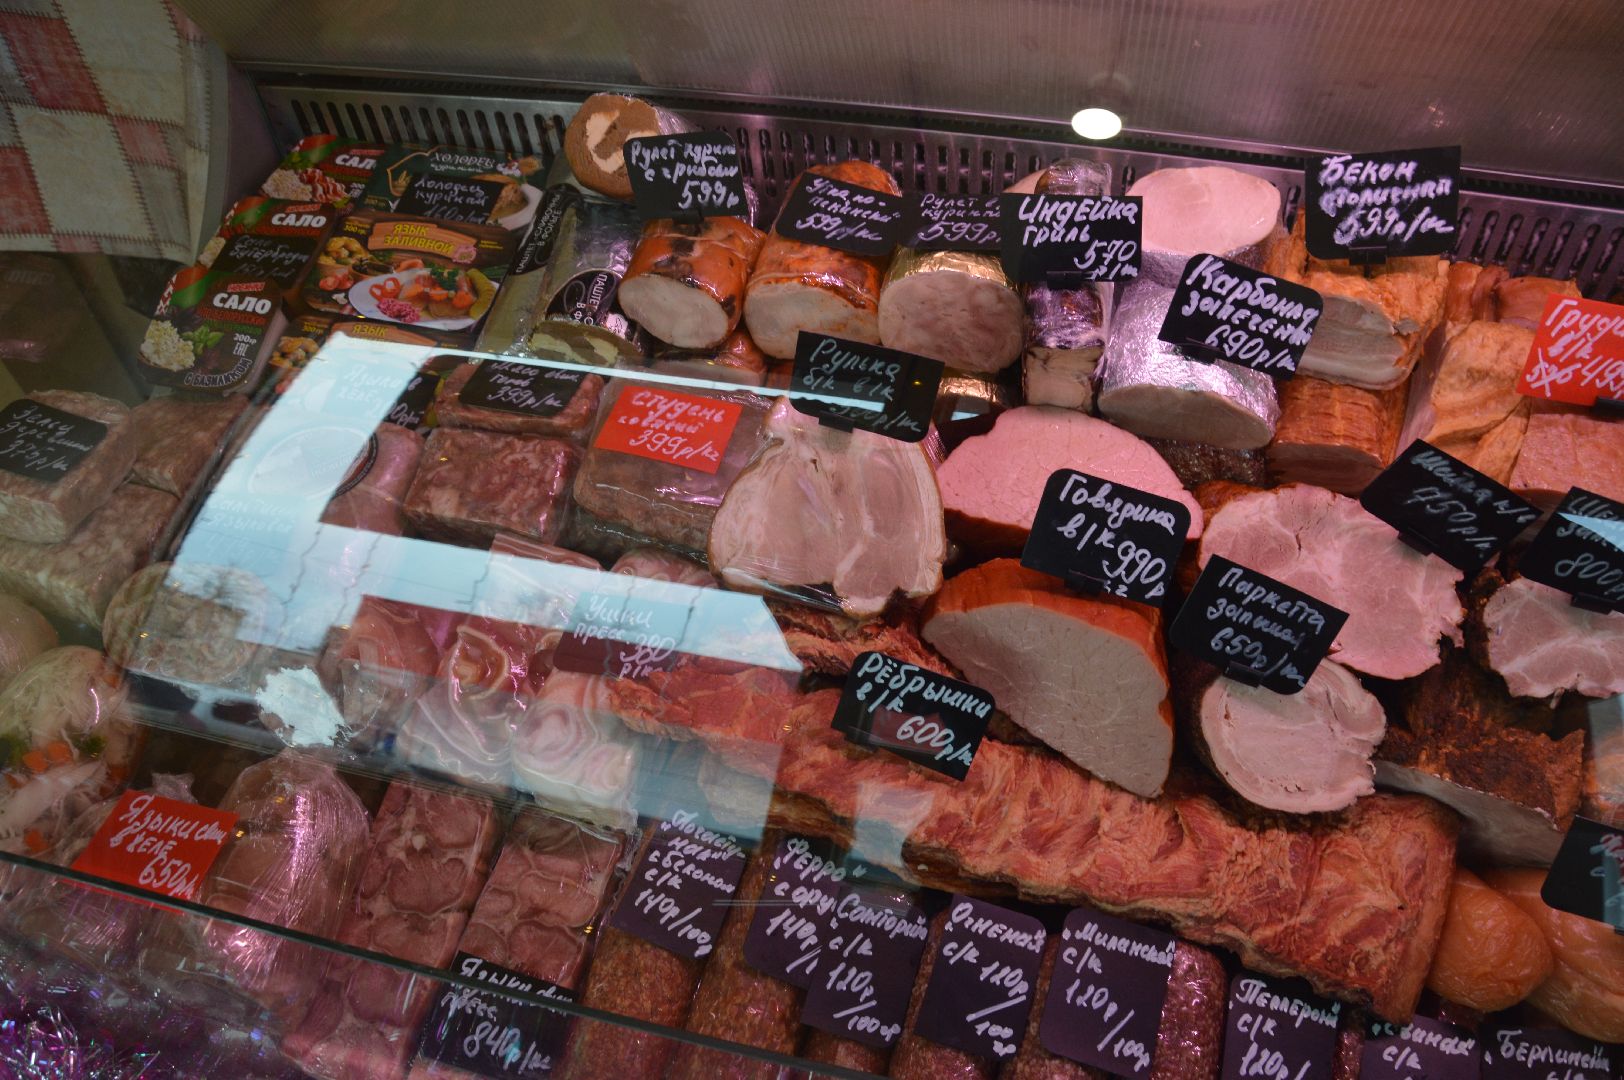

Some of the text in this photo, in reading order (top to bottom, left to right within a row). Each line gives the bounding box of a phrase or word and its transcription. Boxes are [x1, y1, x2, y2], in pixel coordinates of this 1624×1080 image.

[631, 139, 682, 170] Рулет
[1318, 154, 1418, 187] Бекон
[920, 193, 979, 209] Рулет
[271, 213, 327, 228] САЛО
[393, 224, 430, 236] ЯЗЫК
[383, 235, 455, 254] ЗАЛИВНОЙ
[1023, 224, 1092, 247] гриль
[1073, 240, 1137, 270] 570
[212, 292, 272, 315] САЛО
[589, 273, 608, 313] ПАШТЕТ
[352, 324, 388, 336] ЯЗЫК
[810, 338, 902, 383] Рулька
[632, 390, 726, 423] Студень
[1059, 473, 1176, 537] Говядина
[1057, 512, 1167, 585] в/к 990
[856, 681, 905, 713] в/к
[857, 652, 992, 719] Рёбрышки
[119, 794, 199, 834] Языки
[644, 868, 682, 890] с/к
[828, 933, 873, 958] с/к
[942, 940, 980, 965] с/к
[1062, 946, 1103, 974] с/к
[1236, 1013, 1278, 1042] с/к
[1382, 1045, 1422, 1070] с/к
